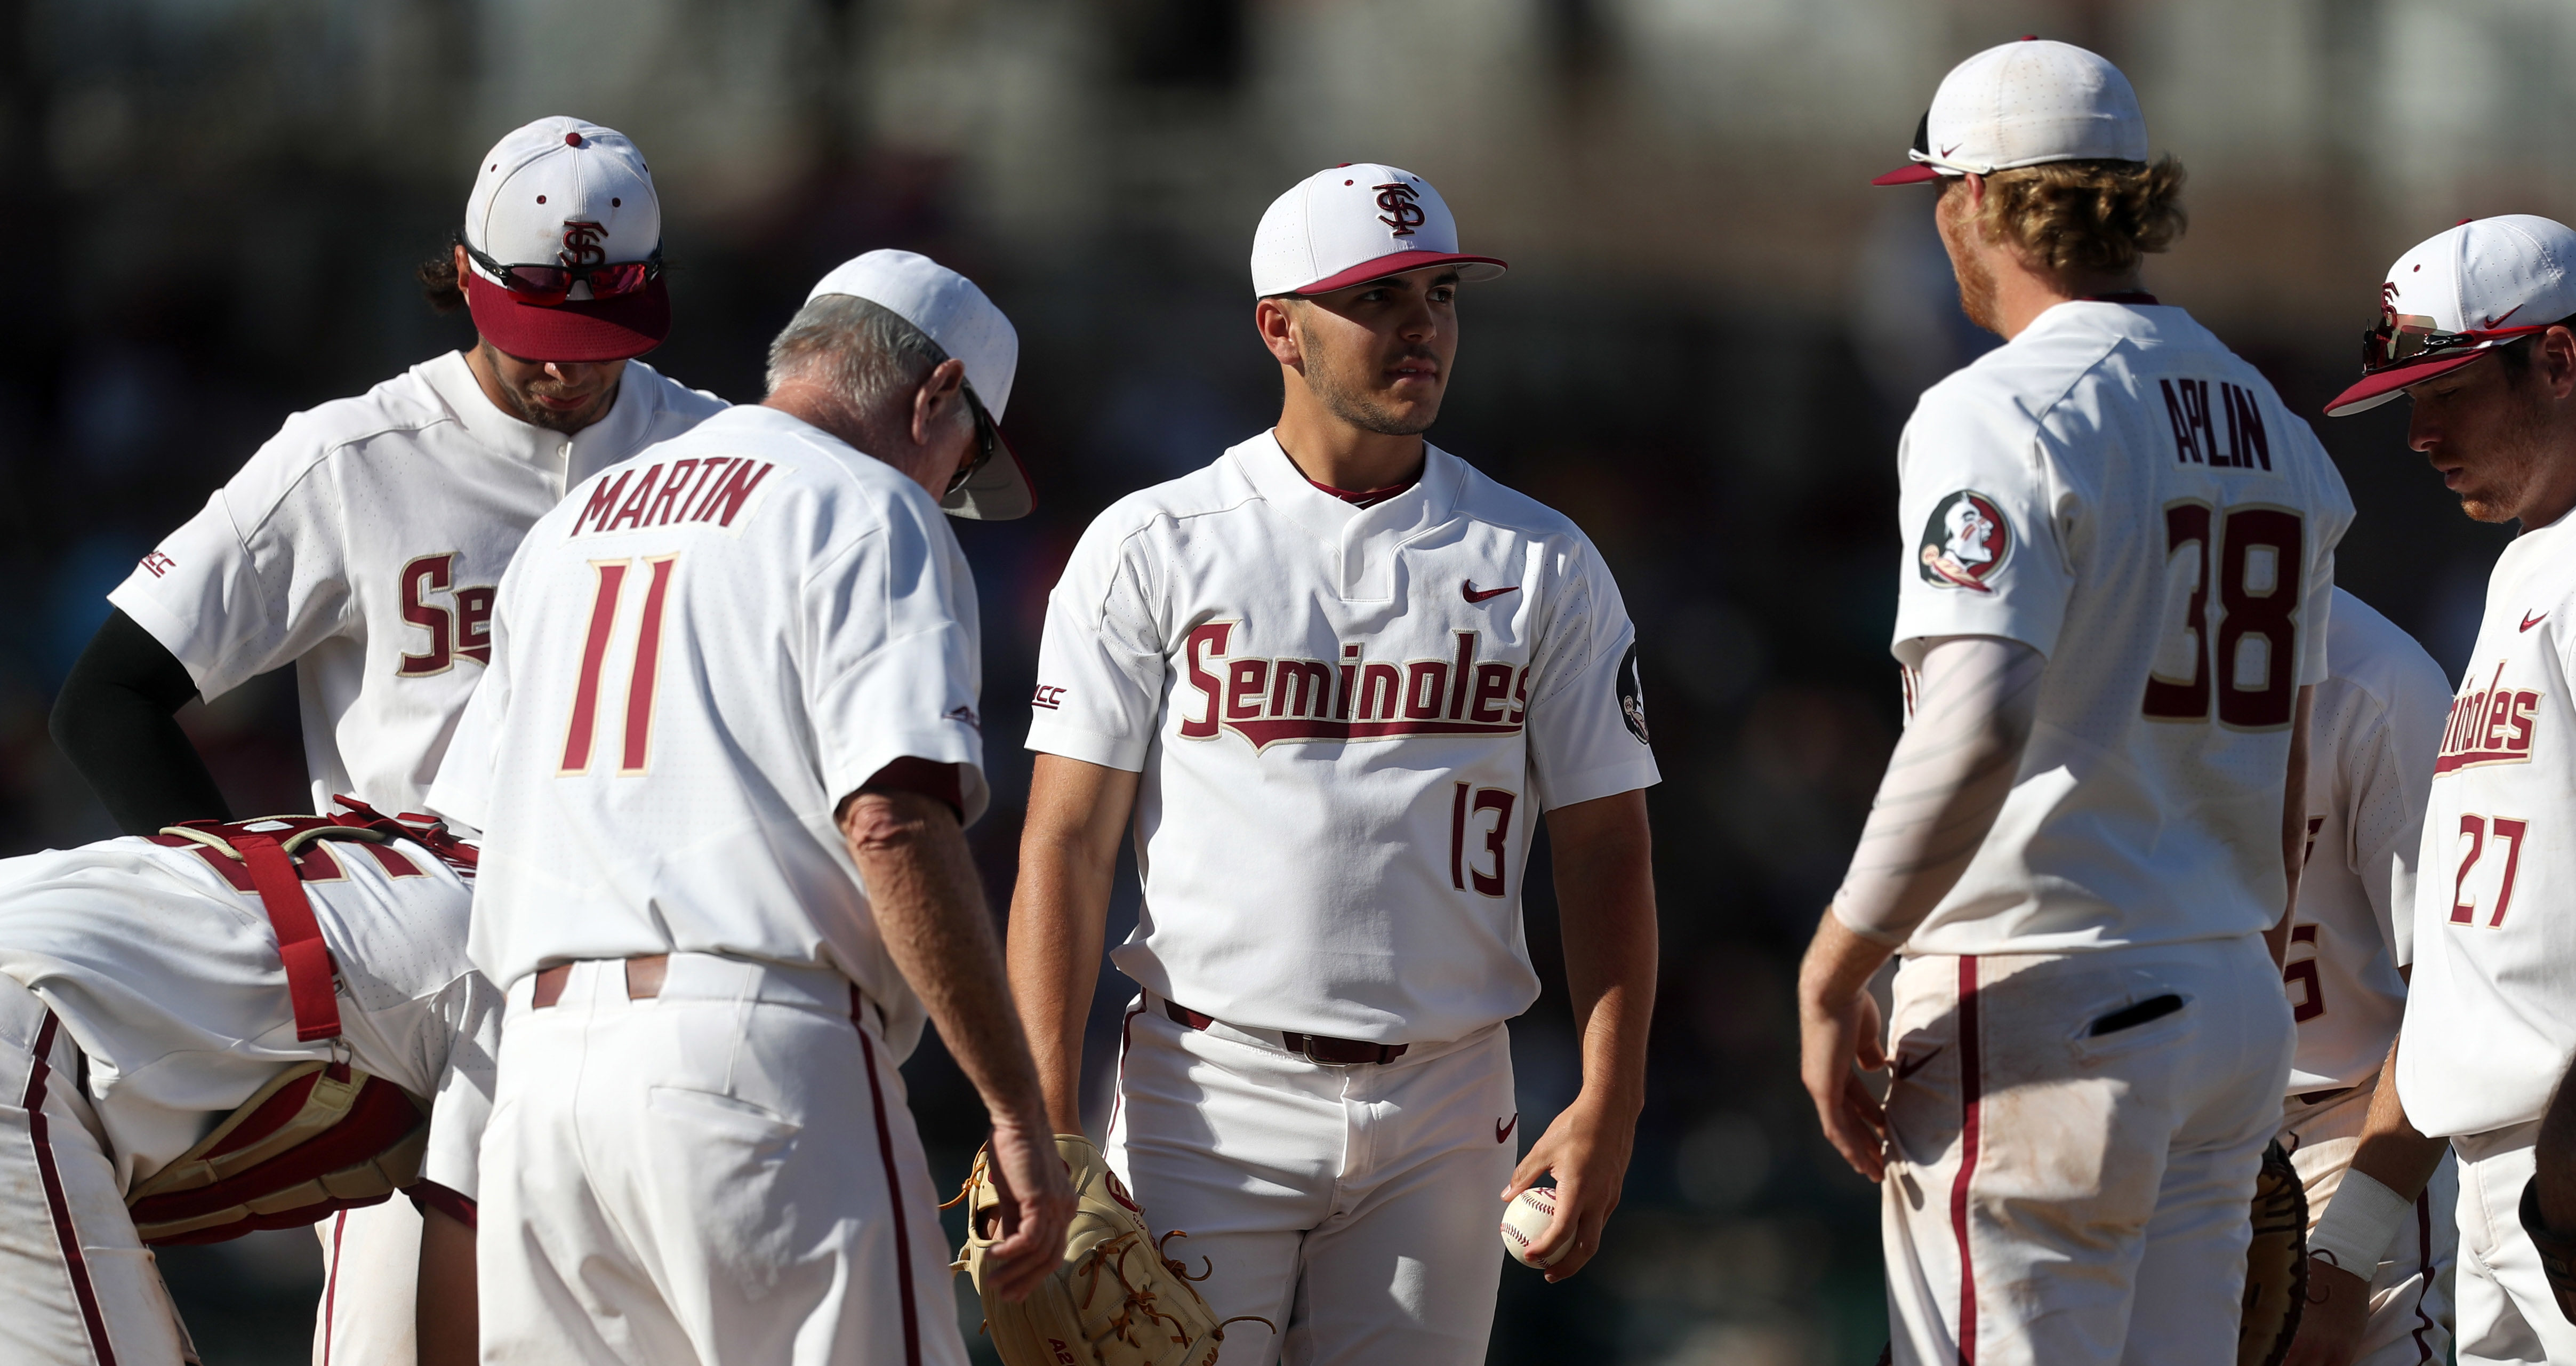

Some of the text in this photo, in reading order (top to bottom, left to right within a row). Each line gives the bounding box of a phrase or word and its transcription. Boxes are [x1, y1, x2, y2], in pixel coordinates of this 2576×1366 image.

[2160, 378, 2272, 472] APLIN
[569, 457, 775, 538] MARTIN
[556, 552, 680, 779] 11
[2141, 496, 2306, 733] 38
[1177, 619, 1529, 747] Seminoles
[1449, 780, 1517, 899] 13
[2447, 812, 2529, 930] 27
